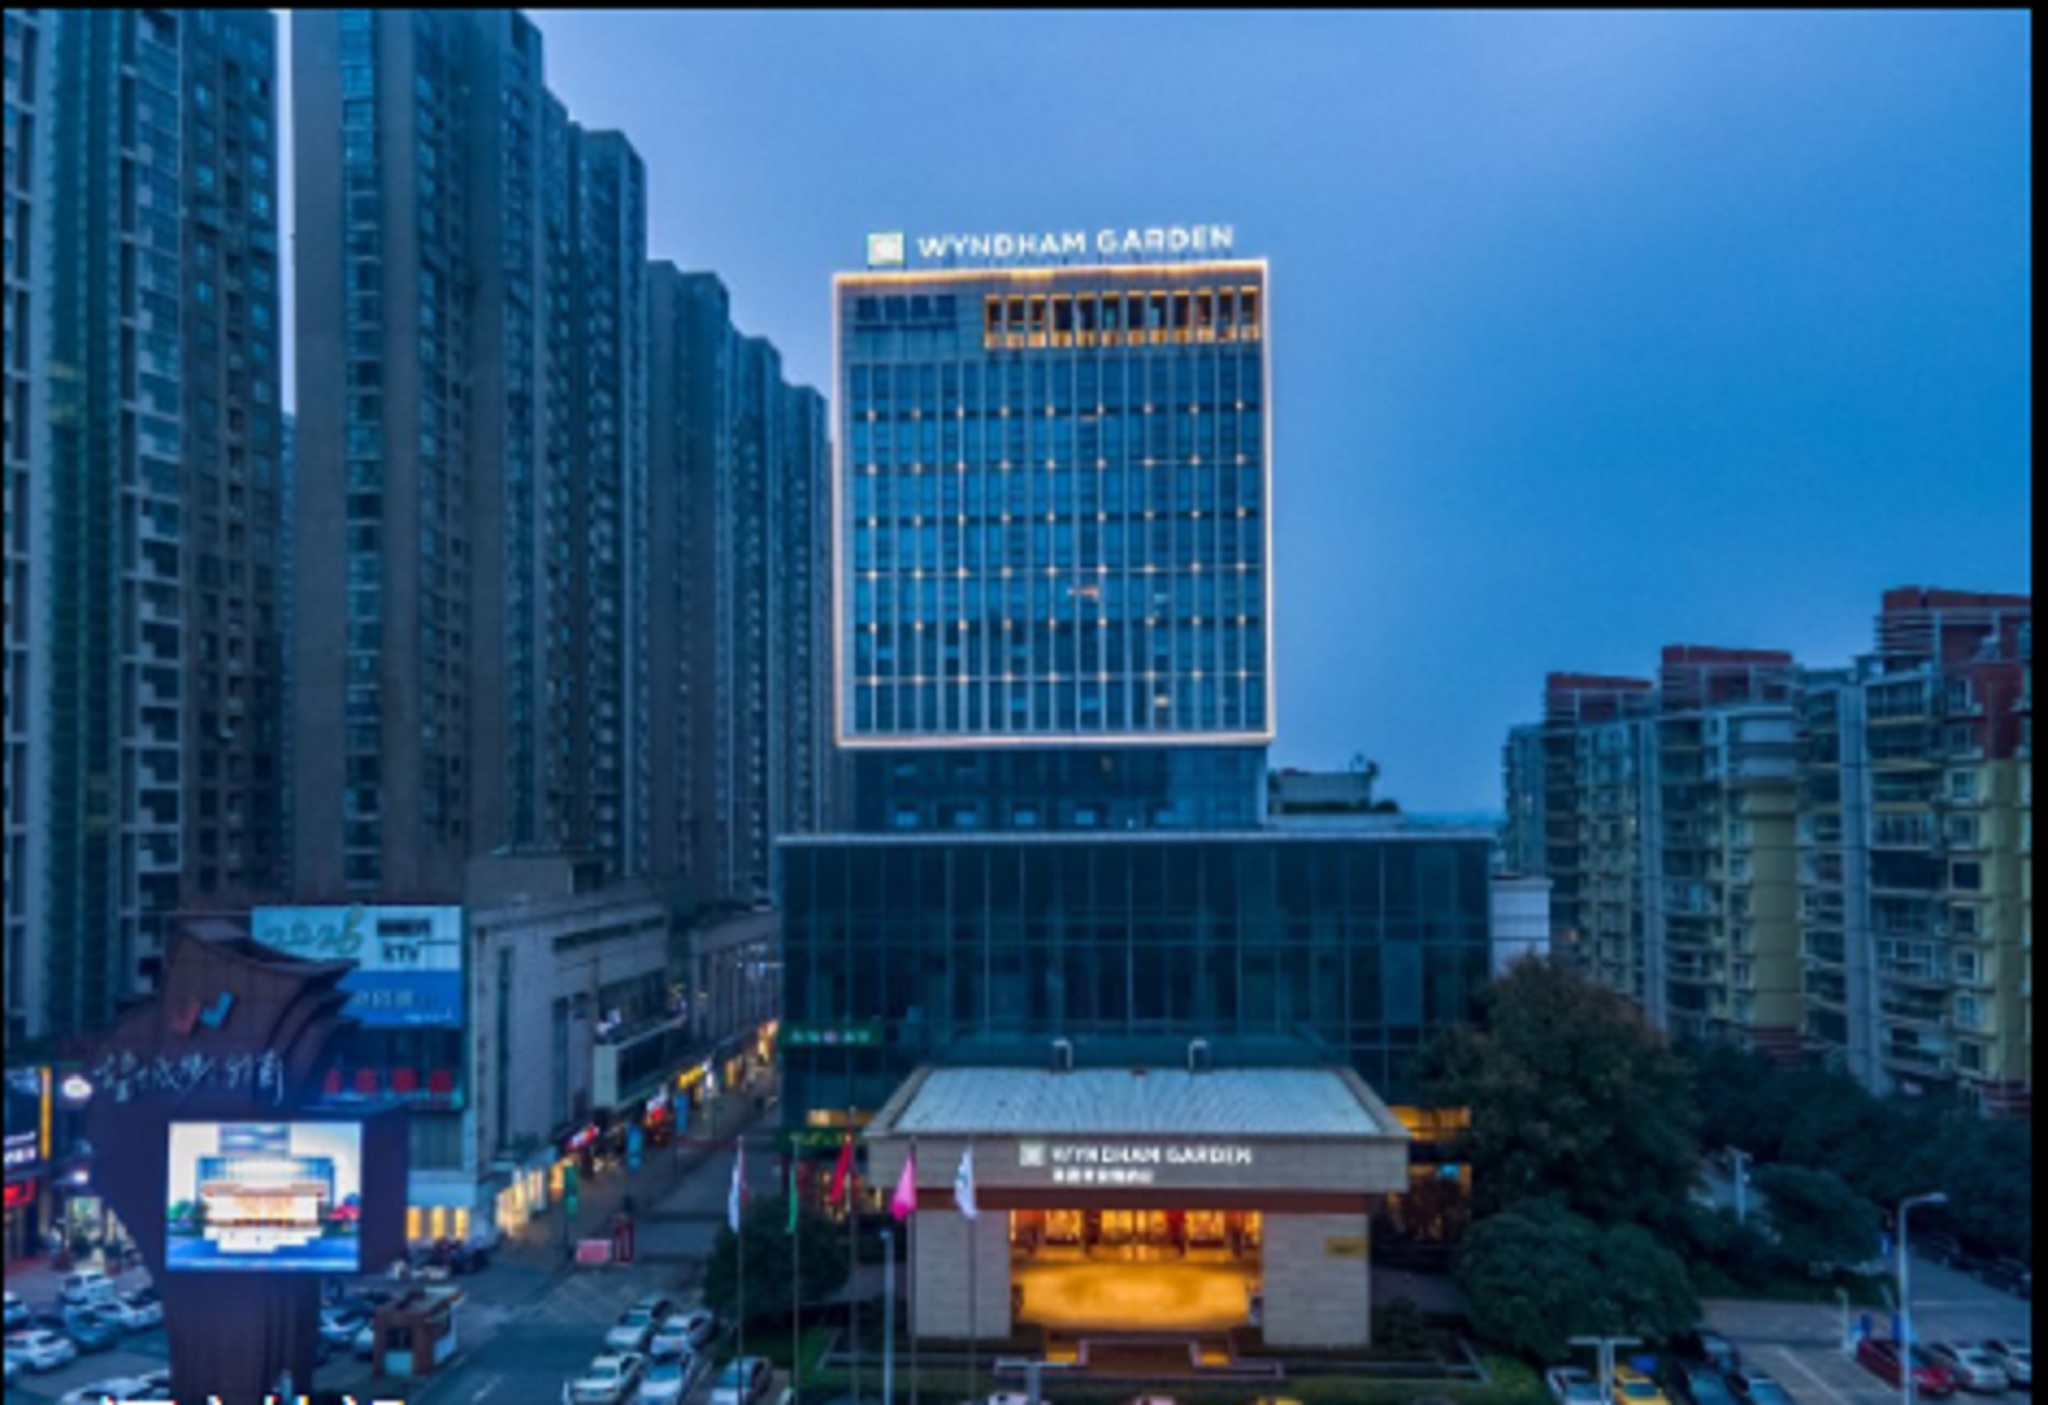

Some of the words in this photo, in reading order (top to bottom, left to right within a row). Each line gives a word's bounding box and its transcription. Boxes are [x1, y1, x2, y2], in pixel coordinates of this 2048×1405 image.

[917, 231, 1086, 257] WYNDHAM
[1096, 224, 1234, 252] GARDEN
[1052, 1145, 1160, 1164] WYNDHAM
[1166, 1145, 1253, 1165] GARDEN
